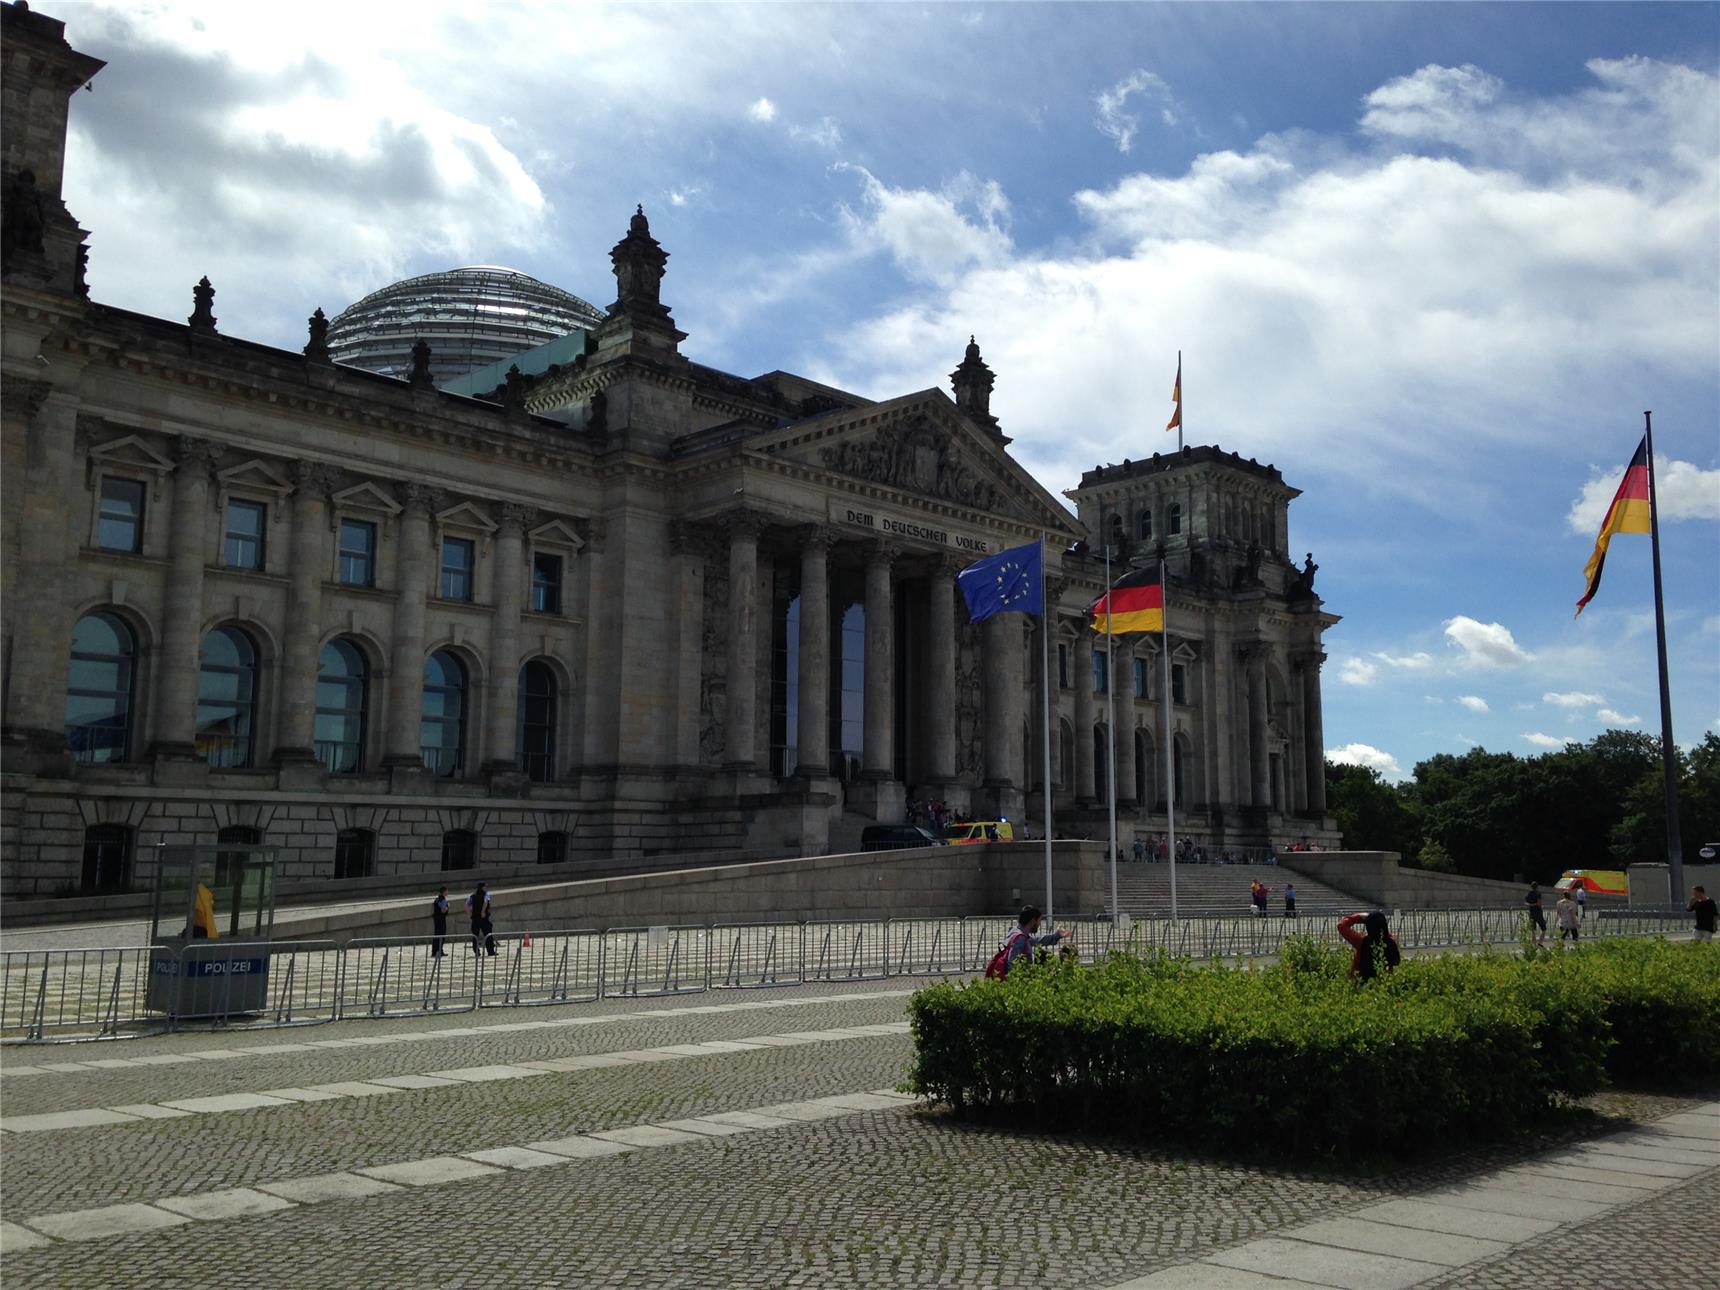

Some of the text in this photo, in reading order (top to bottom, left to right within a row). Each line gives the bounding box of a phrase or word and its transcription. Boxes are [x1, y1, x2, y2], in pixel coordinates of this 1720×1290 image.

[847, 510, 987, 553] DEM DEUTSCHEN VOLKE
